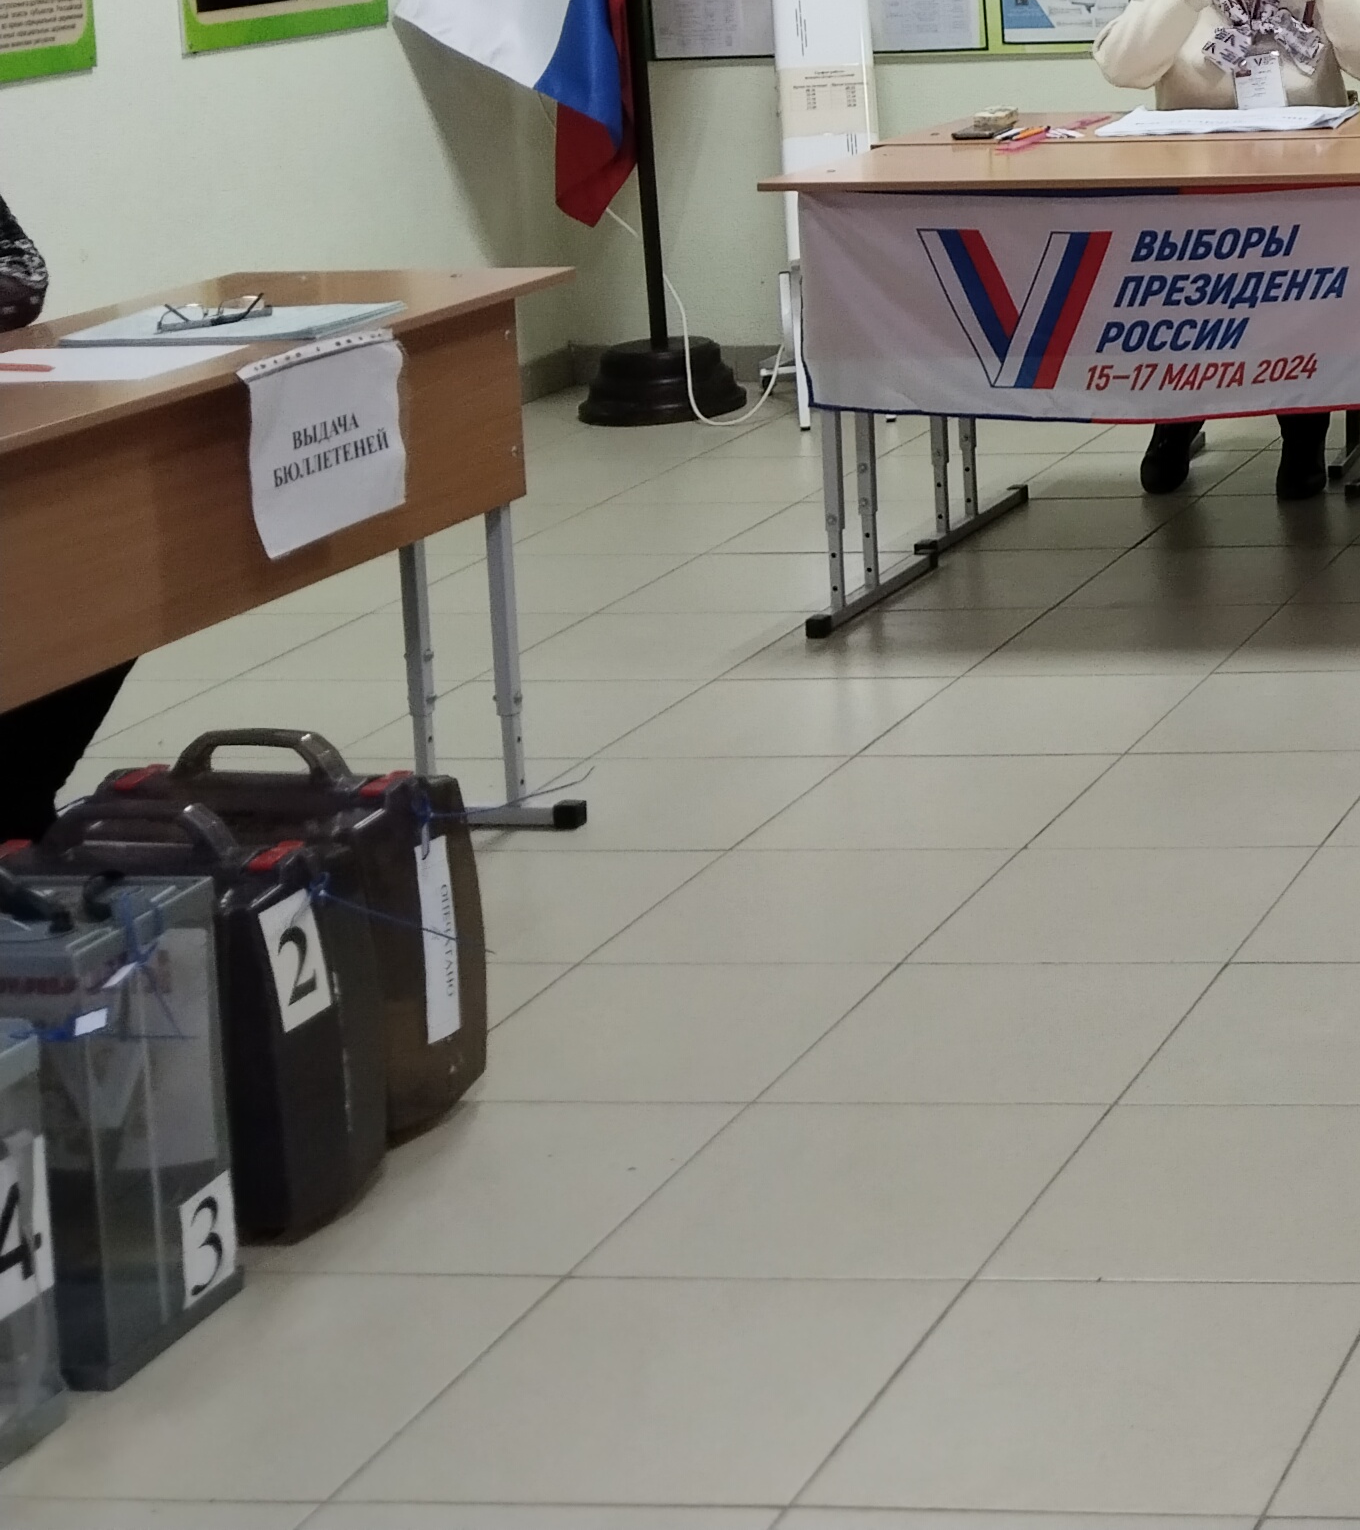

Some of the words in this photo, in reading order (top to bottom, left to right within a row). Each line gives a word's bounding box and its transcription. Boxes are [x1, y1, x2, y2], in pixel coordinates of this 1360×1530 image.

[1130, 224, 1300, 264] ВЫБОРЫ
[1113, 265, 1348, 310] ПРЕЗИДЕНТА
[1095, 316, 1250, 354] РОССИИ
[1085, 363, 1159, 392] 15–17
[1160, 361, 1247, 392] МАРТА
[1251, 352, 1319, 386] 2024
[291, 411, 360, 451] ВЫДАЧА
[273, 428, 391, 489] БЮЛЛЕТЕНЕЙ
[275, 923, 319, 1009] 2
[0, 1181, 42, 1282] 4
[190, 1194, 226, 1299] 3
